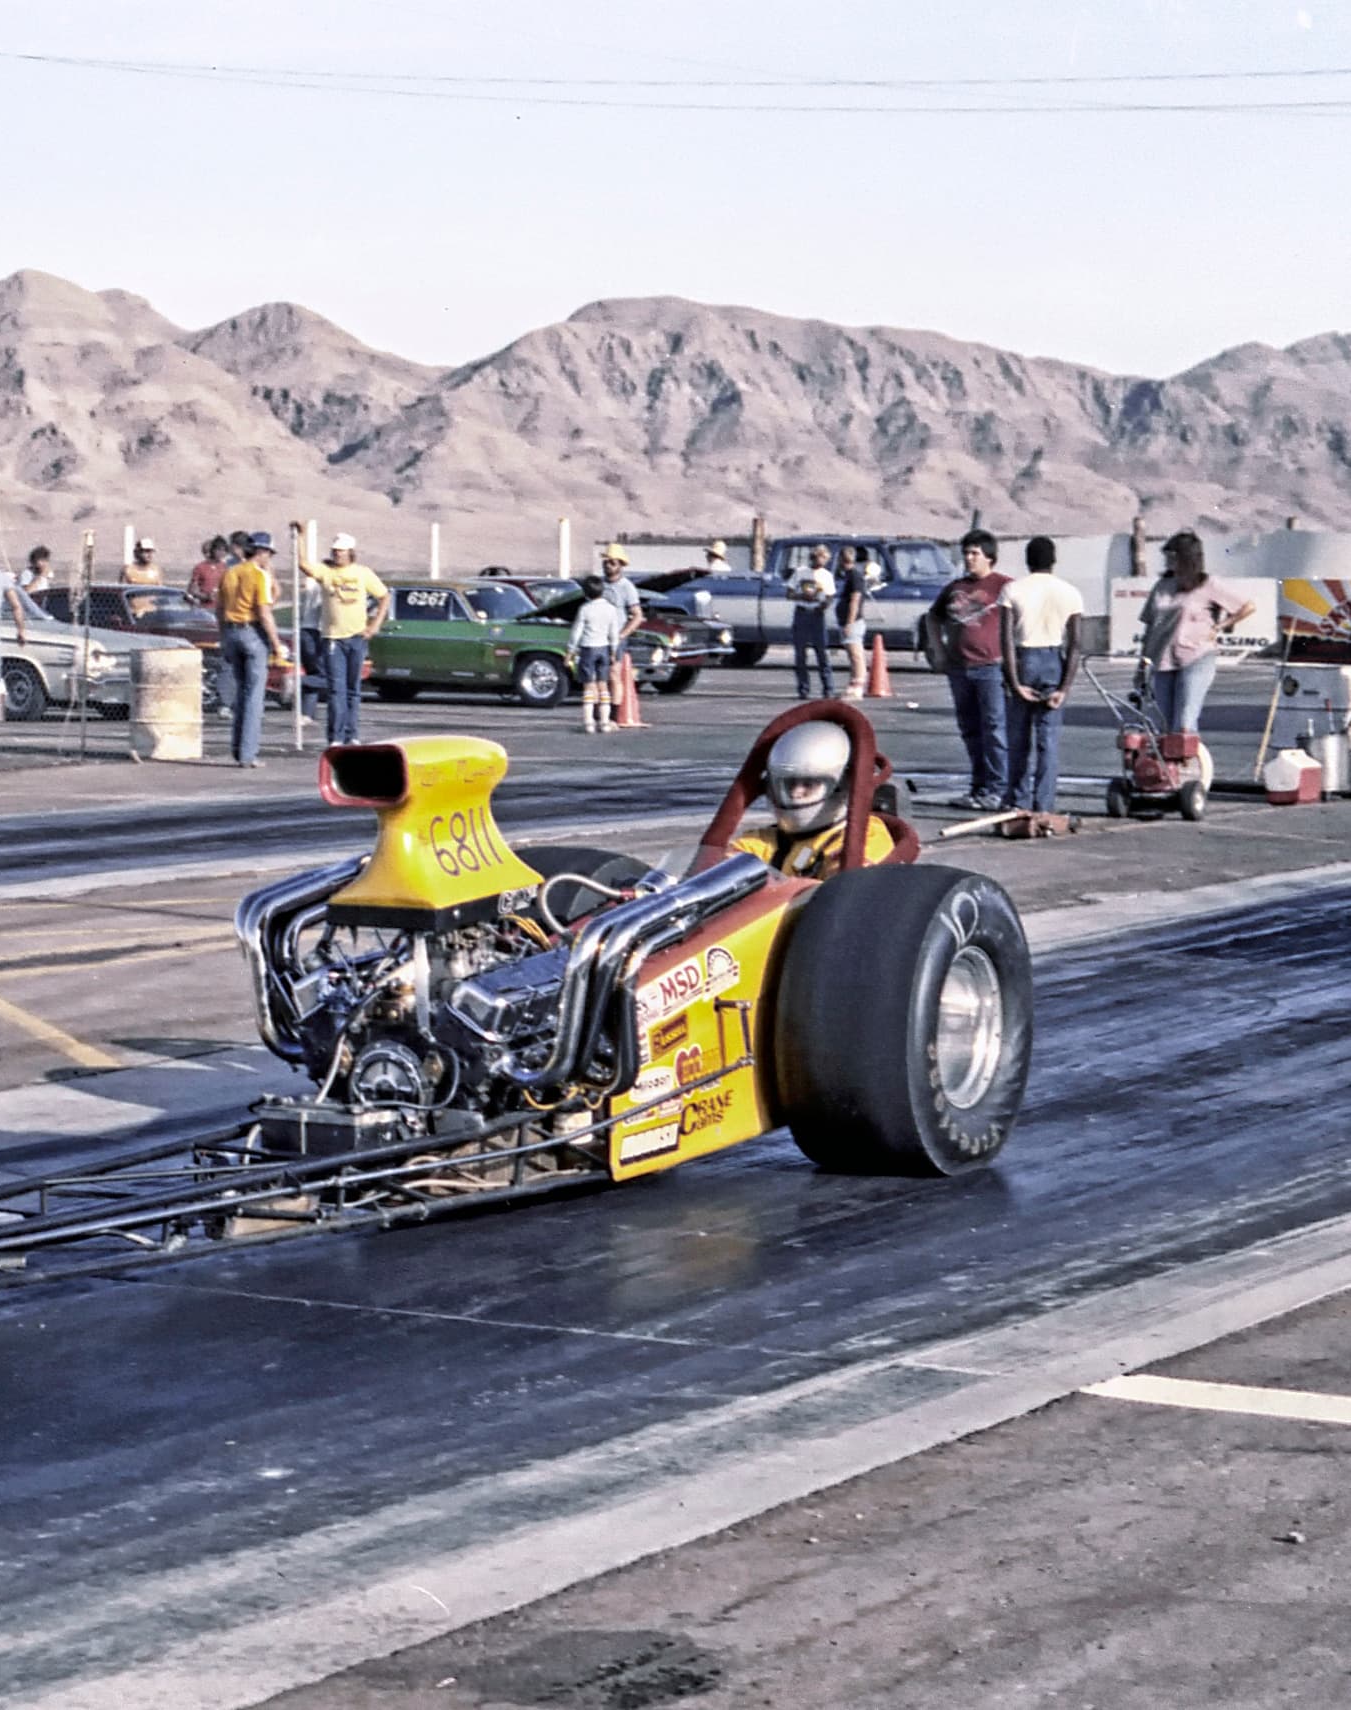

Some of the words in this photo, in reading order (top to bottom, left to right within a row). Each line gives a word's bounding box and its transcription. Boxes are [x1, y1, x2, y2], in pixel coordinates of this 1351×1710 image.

[406, 590, 450, 607] 6267
[429, 805, 504, 877] 6811
[658, 965, 701, 1006] MSD
